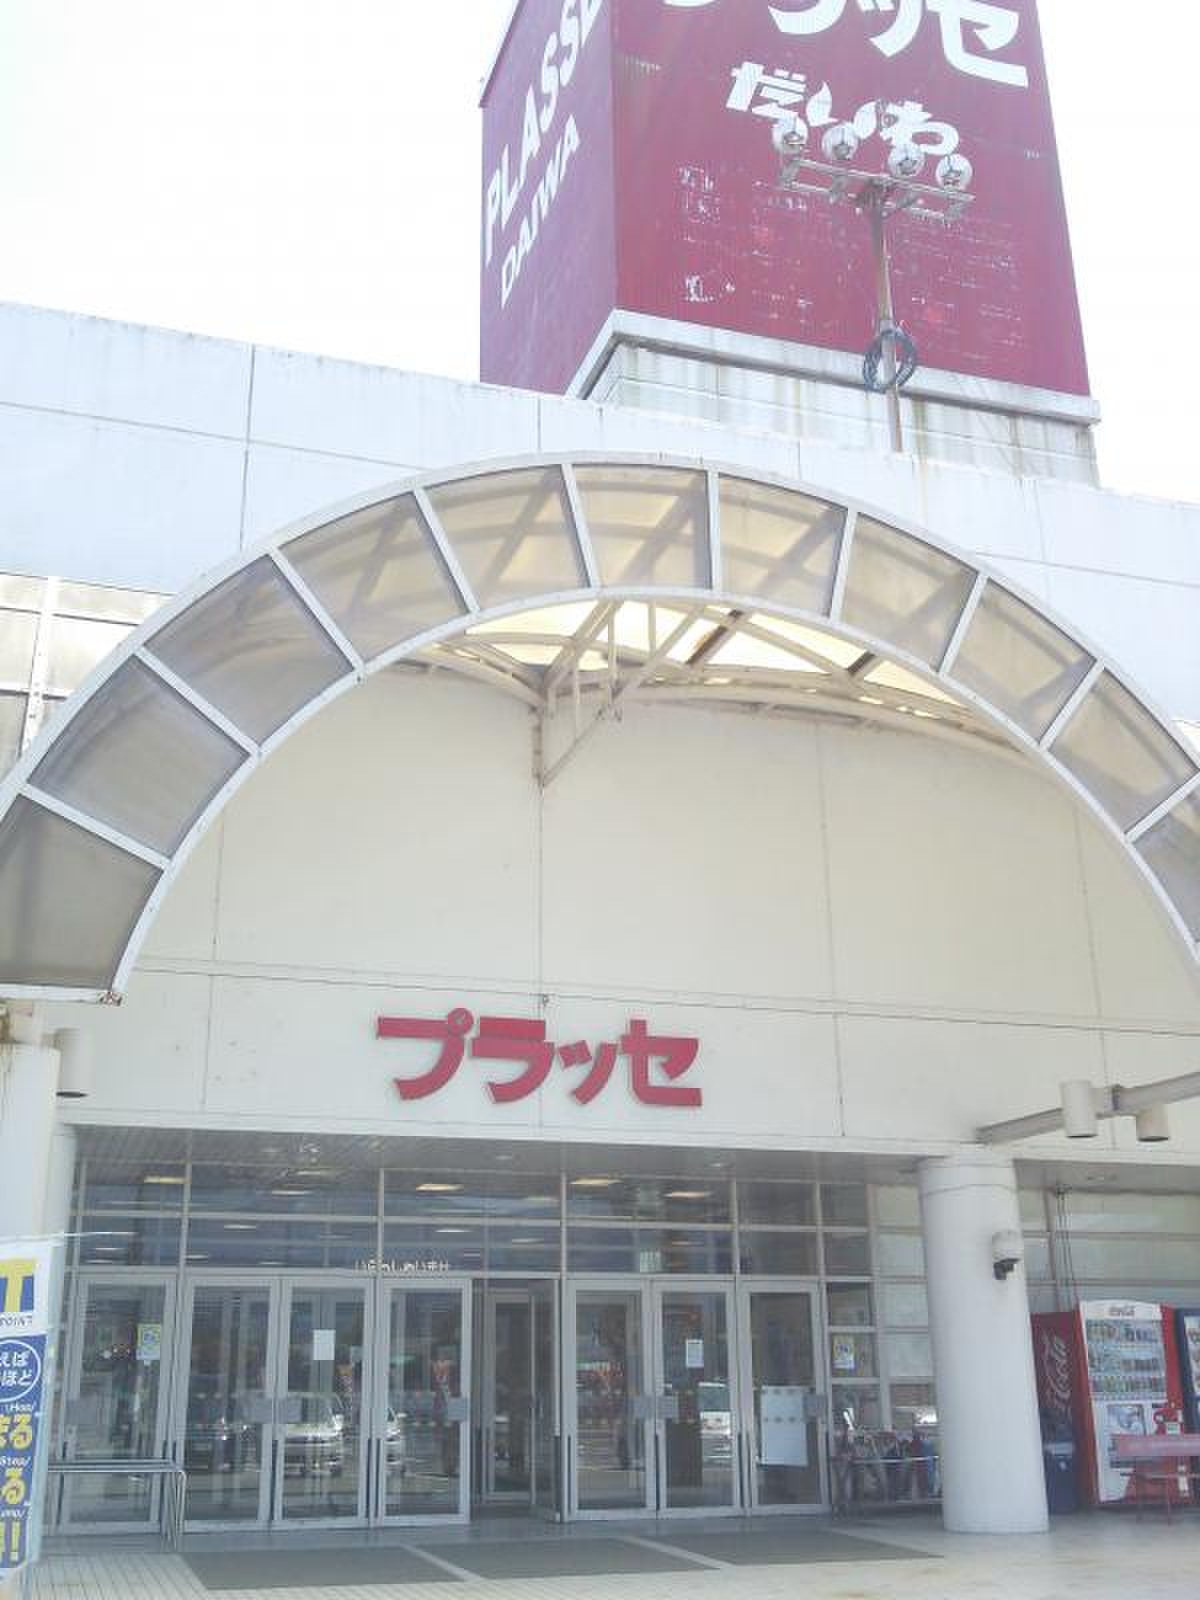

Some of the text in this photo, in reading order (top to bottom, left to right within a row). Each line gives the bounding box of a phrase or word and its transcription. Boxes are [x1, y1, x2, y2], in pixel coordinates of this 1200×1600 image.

[501, 113, 580, 309] DAIWA
[376, 1007, 702, 1108] プラッセ
